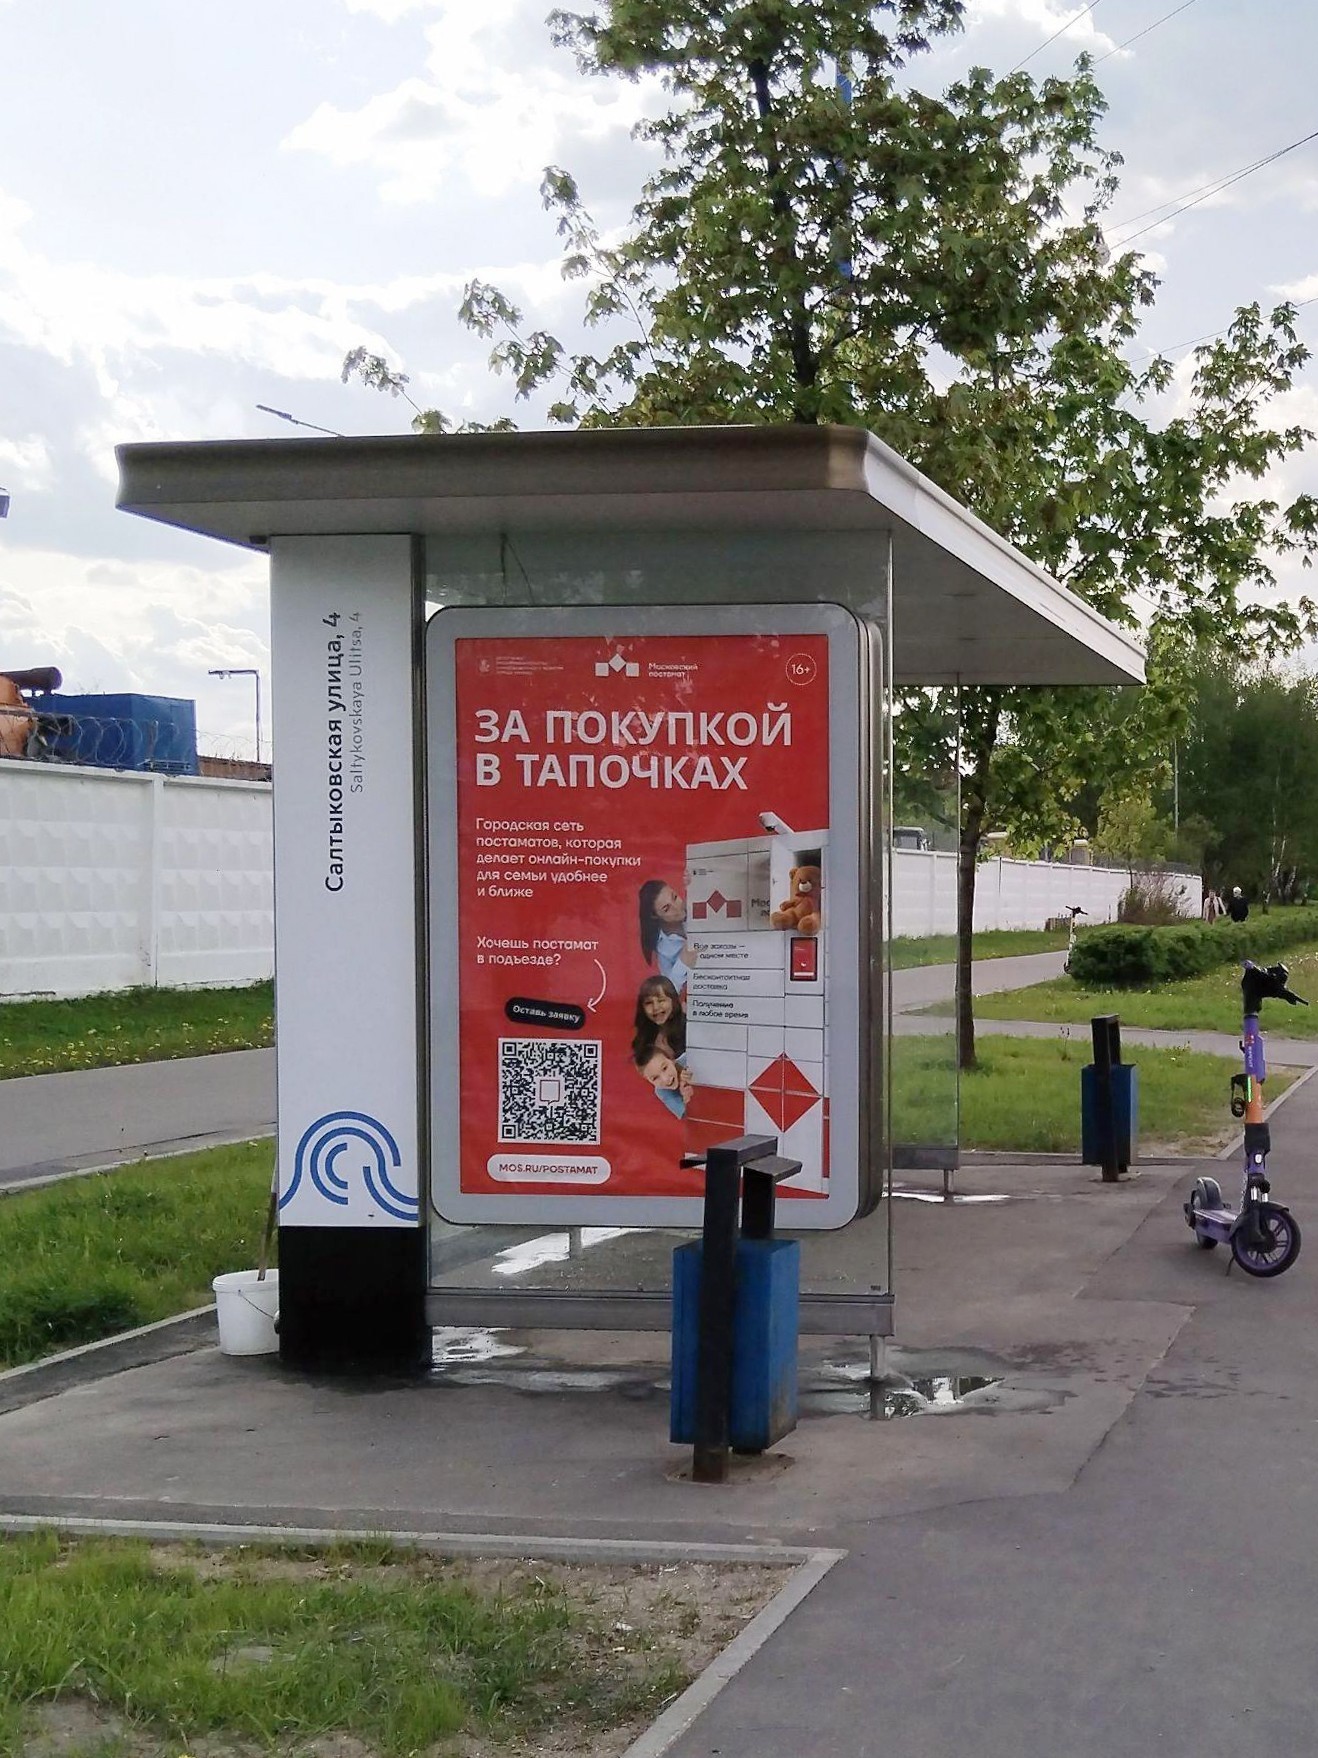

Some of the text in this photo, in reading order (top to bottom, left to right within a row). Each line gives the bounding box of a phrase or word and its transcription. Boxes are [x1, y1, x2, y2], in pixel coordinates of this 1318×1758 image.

[791, 663, 811, 675] 16+
[348, 611, 367, 794] Saltykovskaya Ulitsa, 4
[474, 702, 792, 747] ЗА ПОКУПКОЙ
[322, 611, 347, 892] Салтыковская улица, 4
[476, 752, 748, 790] В ТАПОЧКАХ
[475, 817, 585, 832] Городская сеть
[476, 836, 622, 852] постаматов, которая
[476, 852, 641, 868] делает онлайн-покупки
[476, 870, 608, 884] для семьи удобнее
[477, 884, 534, 898] и ближе
[476, 936, 599, 950] Хочешь постамат
[476, 953, 562, 966] в подъезде?
[512, 1004, 580, 1023] Оставь заявку
[498, 1162, 599, 1176] MOS.RU/POSTAMAT
